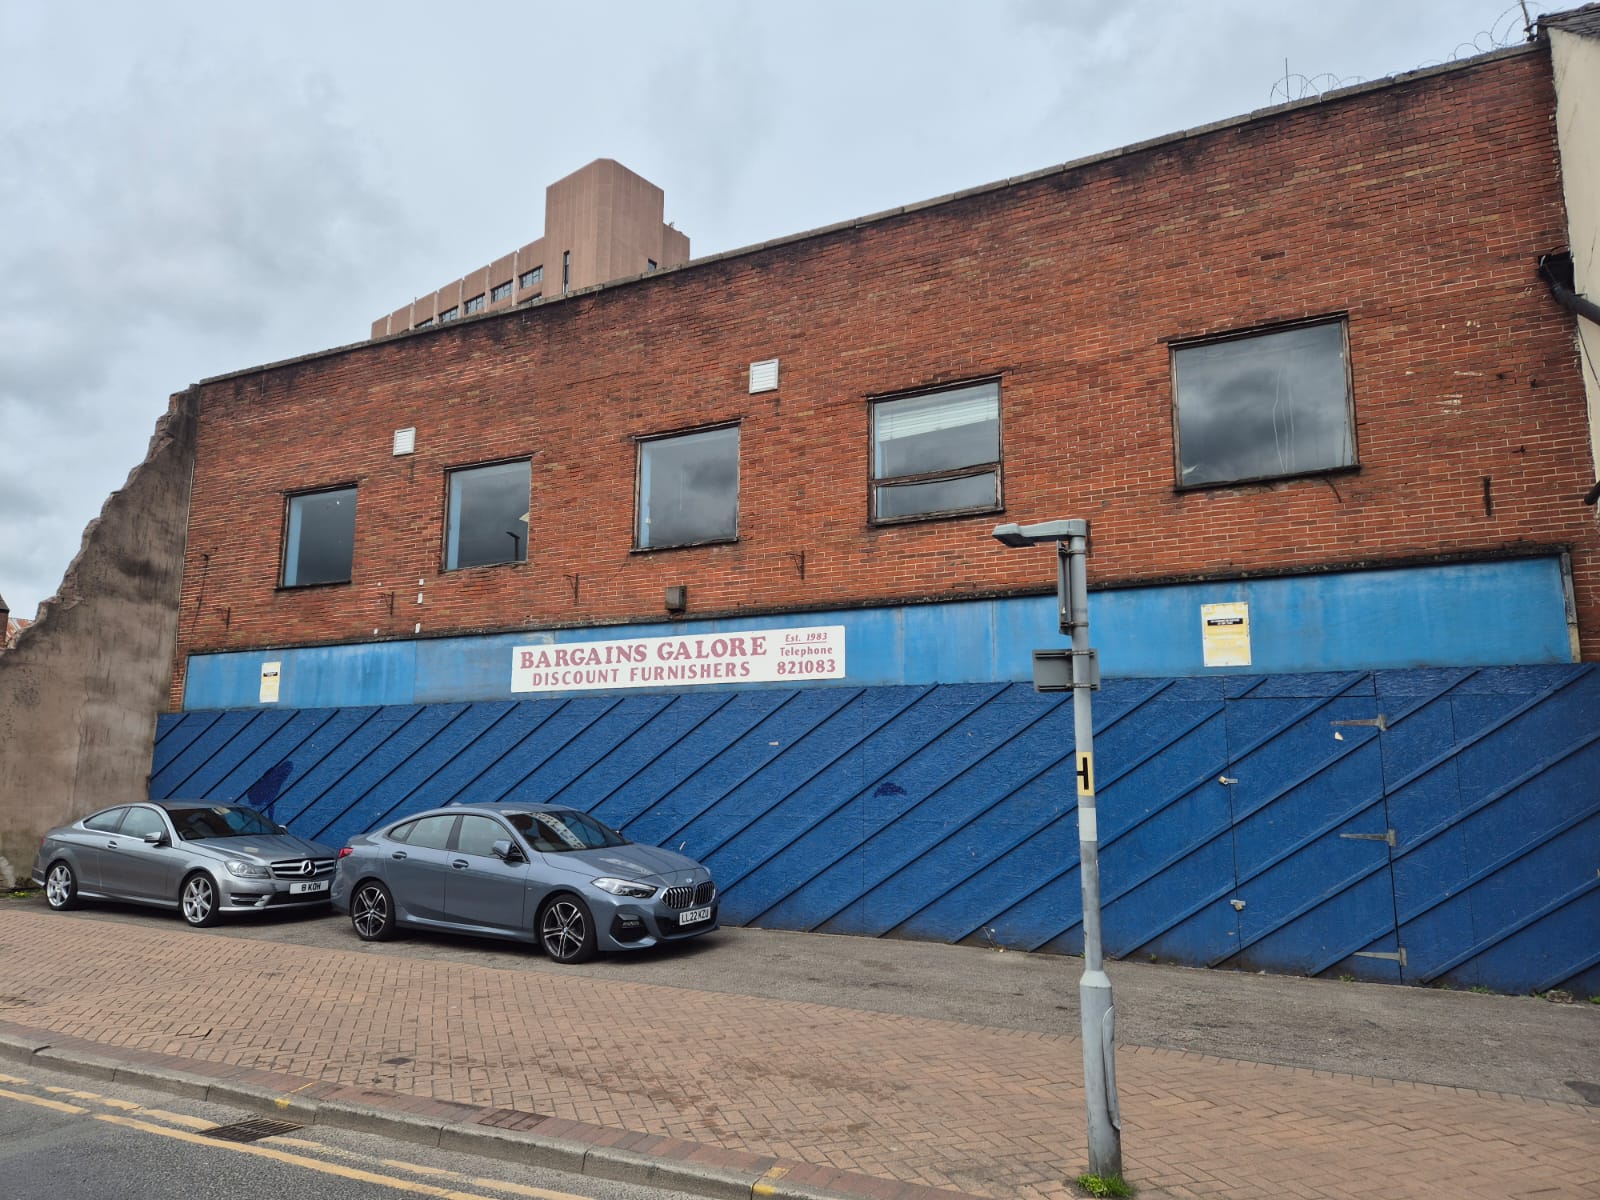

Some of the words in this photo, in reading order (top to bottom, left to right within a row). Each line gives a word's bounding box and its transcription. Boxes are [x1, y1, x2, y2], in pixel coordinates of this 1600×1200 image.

[785, 633, 801, 642] Est.
[806, 632, 828, 641] 1983
[520, 644, 647, 669] BARGAINS
[657, 636, 767, 661] GALORE
[780, 646, 833, 657] Telephone
[532, 669, 620, 686] DISCOUNT
[630, 661, 751, 682] FURNISHERS
[776, 659, 836, 675] 821083
[681, 911, 697, 923] LL22
